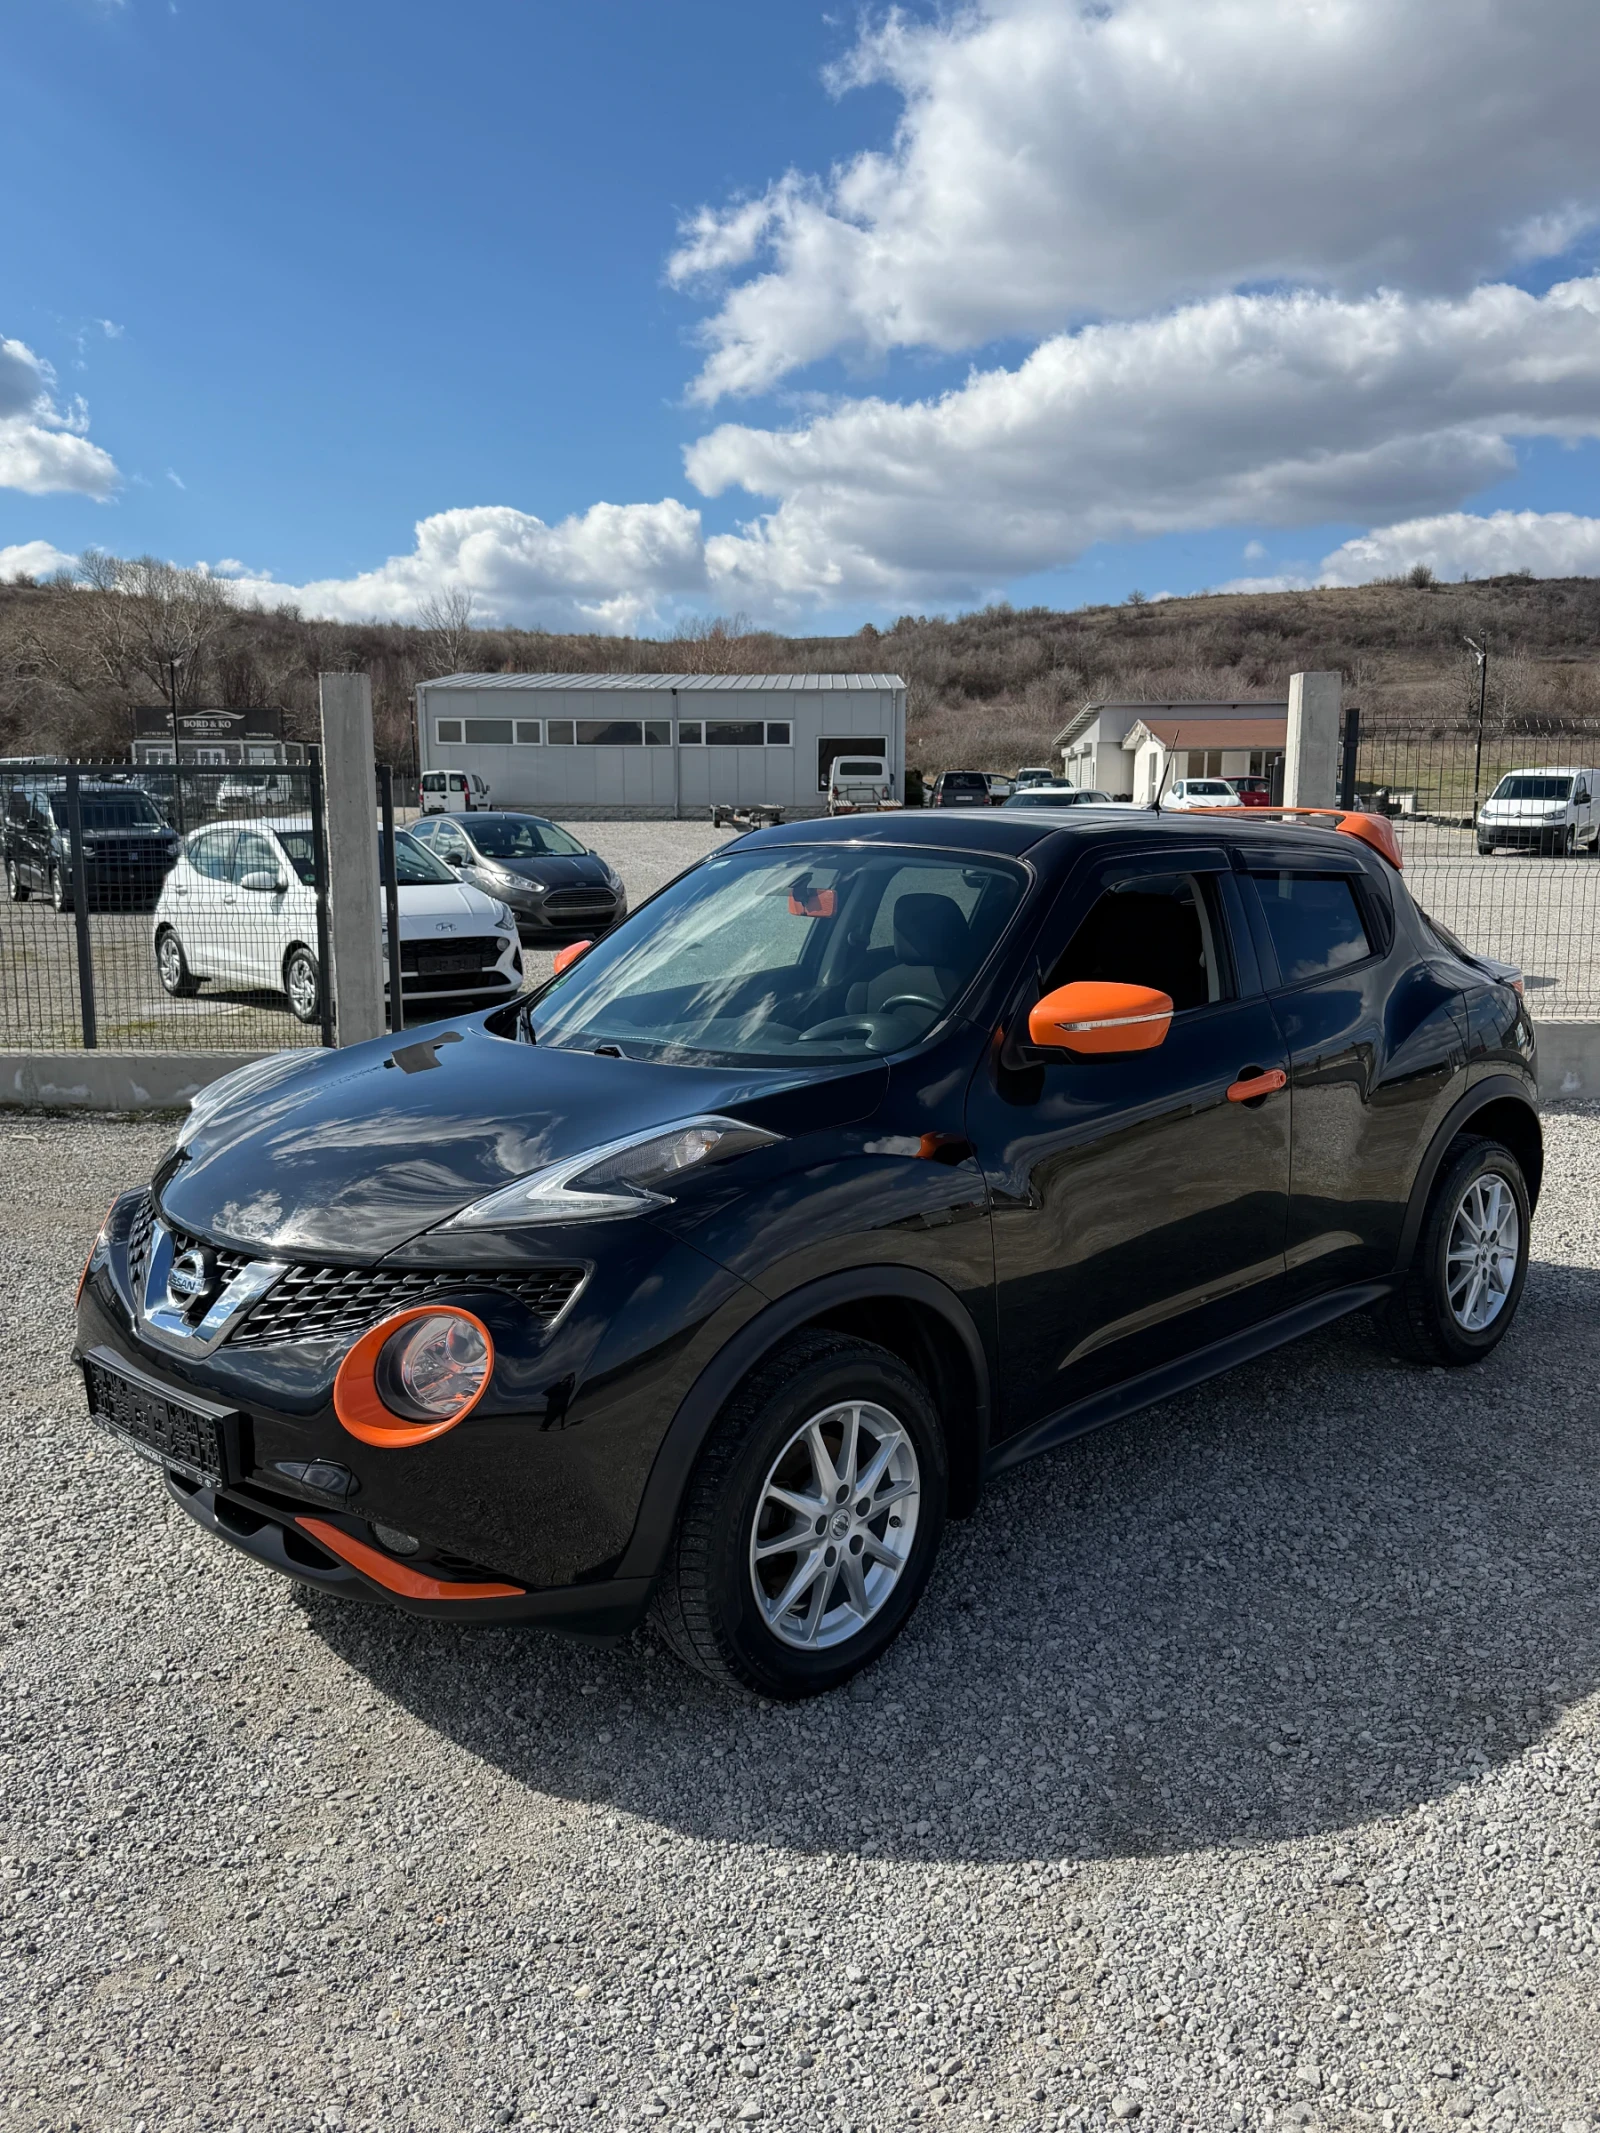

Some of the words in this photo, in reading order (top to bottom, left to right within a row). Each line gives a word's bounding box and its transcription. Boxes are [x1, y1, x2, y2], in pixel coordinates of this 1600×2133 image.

[183, 720, 208, 728] BORD
[210, 720, 217, 728] &
[218, 720, 232, 728] KO
[134, 1442, 163, 1464] AUTOMOBILE
[165, 1459, 187, 1476] KORBACH
